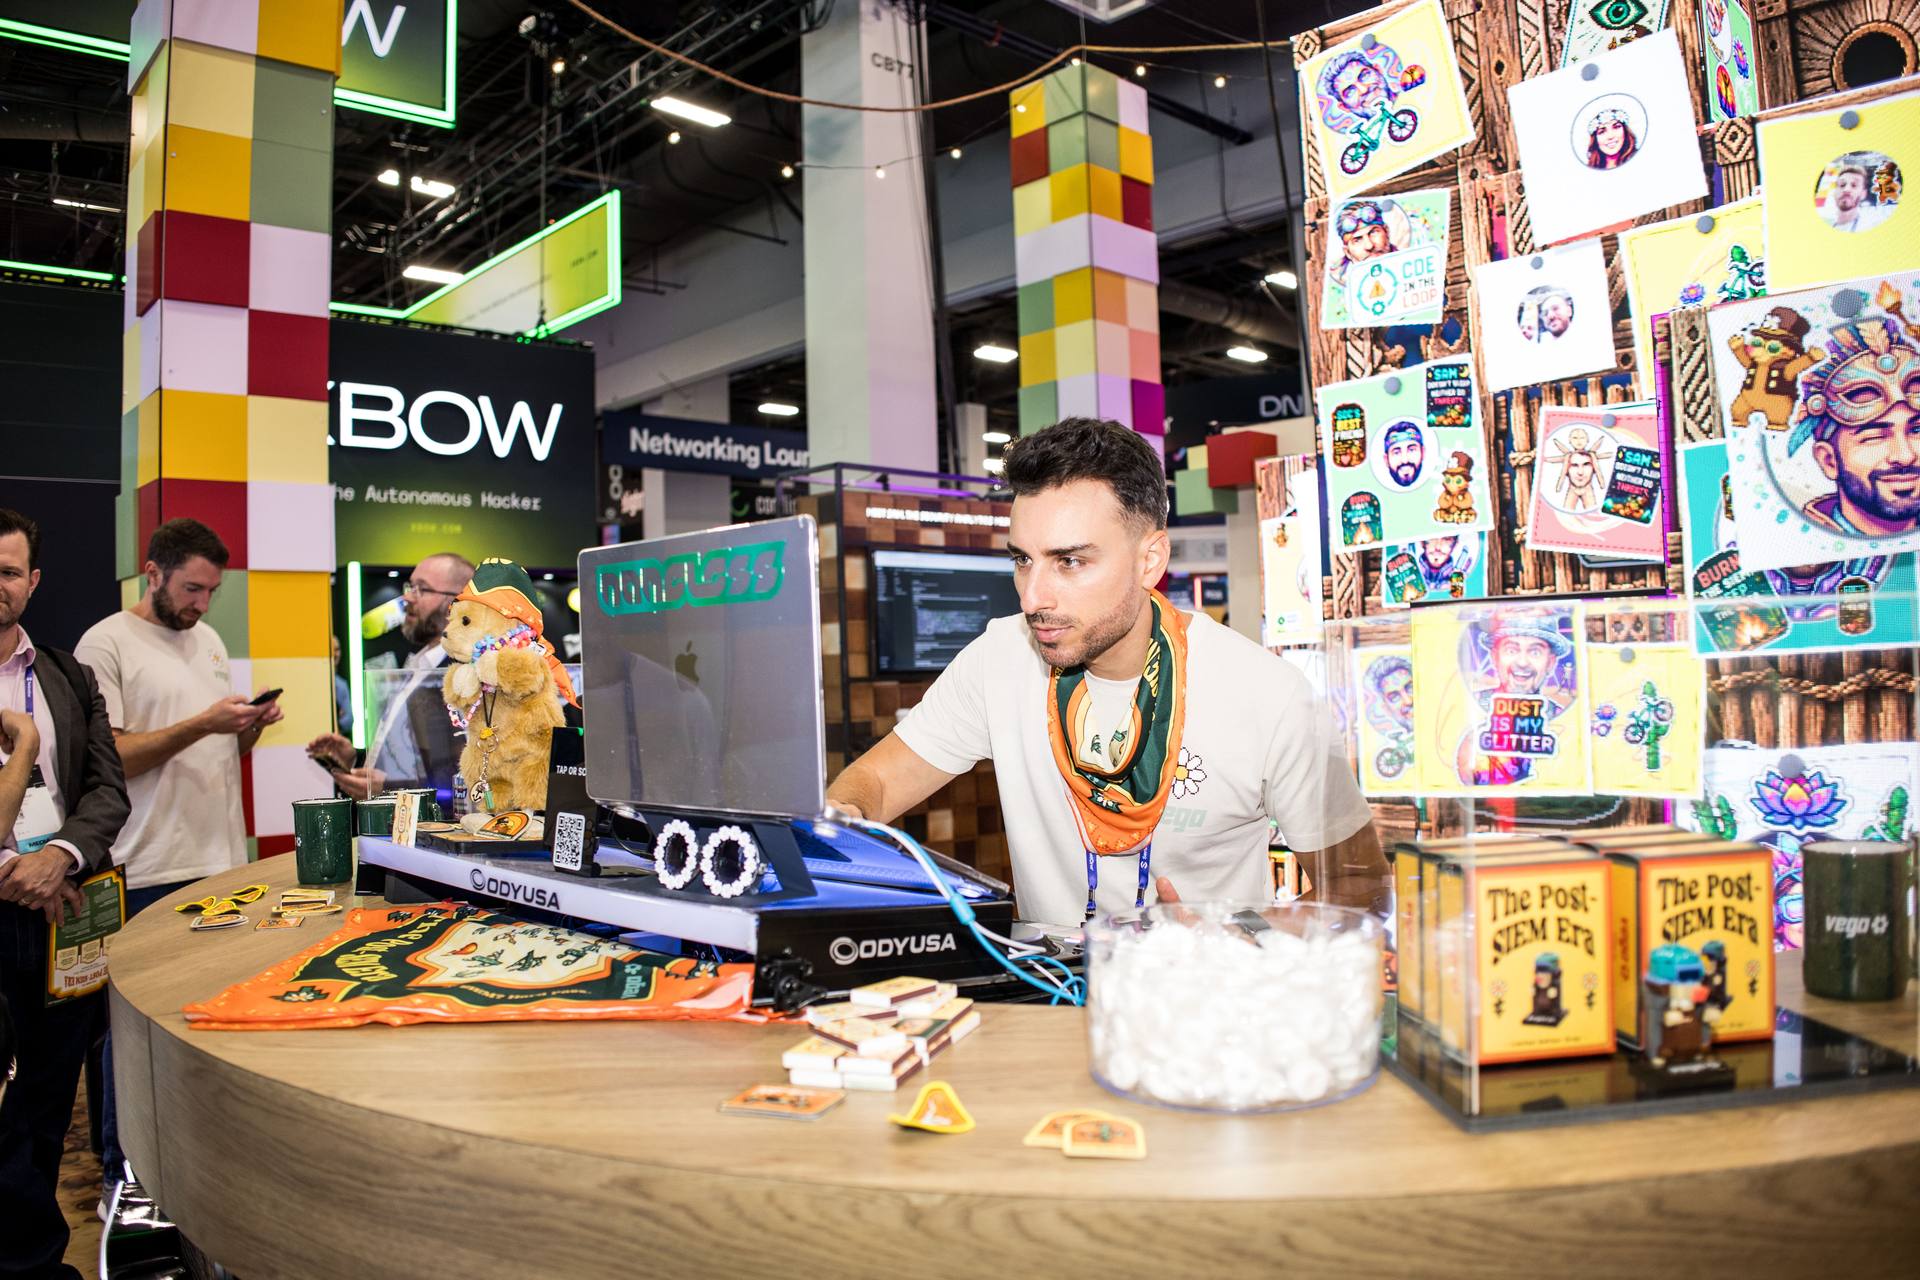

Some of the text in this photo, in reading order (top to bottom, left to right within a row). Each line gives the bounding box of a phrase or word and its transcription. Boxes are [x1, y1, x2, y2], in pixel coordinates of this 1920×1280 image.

[1418, 276, 1435, 288] THE
[1403, 288, 1438, 308] LOOP
[629, 426, 761, 470] Networking
[1625, 450, 1651, 467] SAM
[365, 484, 472, 507] Autonomous
[480, 491, 544, 511] Hacker
[1496, 700, 1542, 716] DUST
[1492, 716, 1542, 734] IS MY
[1480, 733, 1553, 752] GLITTER
[556, 764, 568, 775] TAP
[568, 766, 578, 776] OR
[1658, 872, 1762, 912] The Post-
[1487, 884, 1598, 923] The Post-
[1662, 906, 1760, 946] SIEM Era
[1492, 917, 1548, 966] SIEM
[1556, 916, 1596, 957] Era
